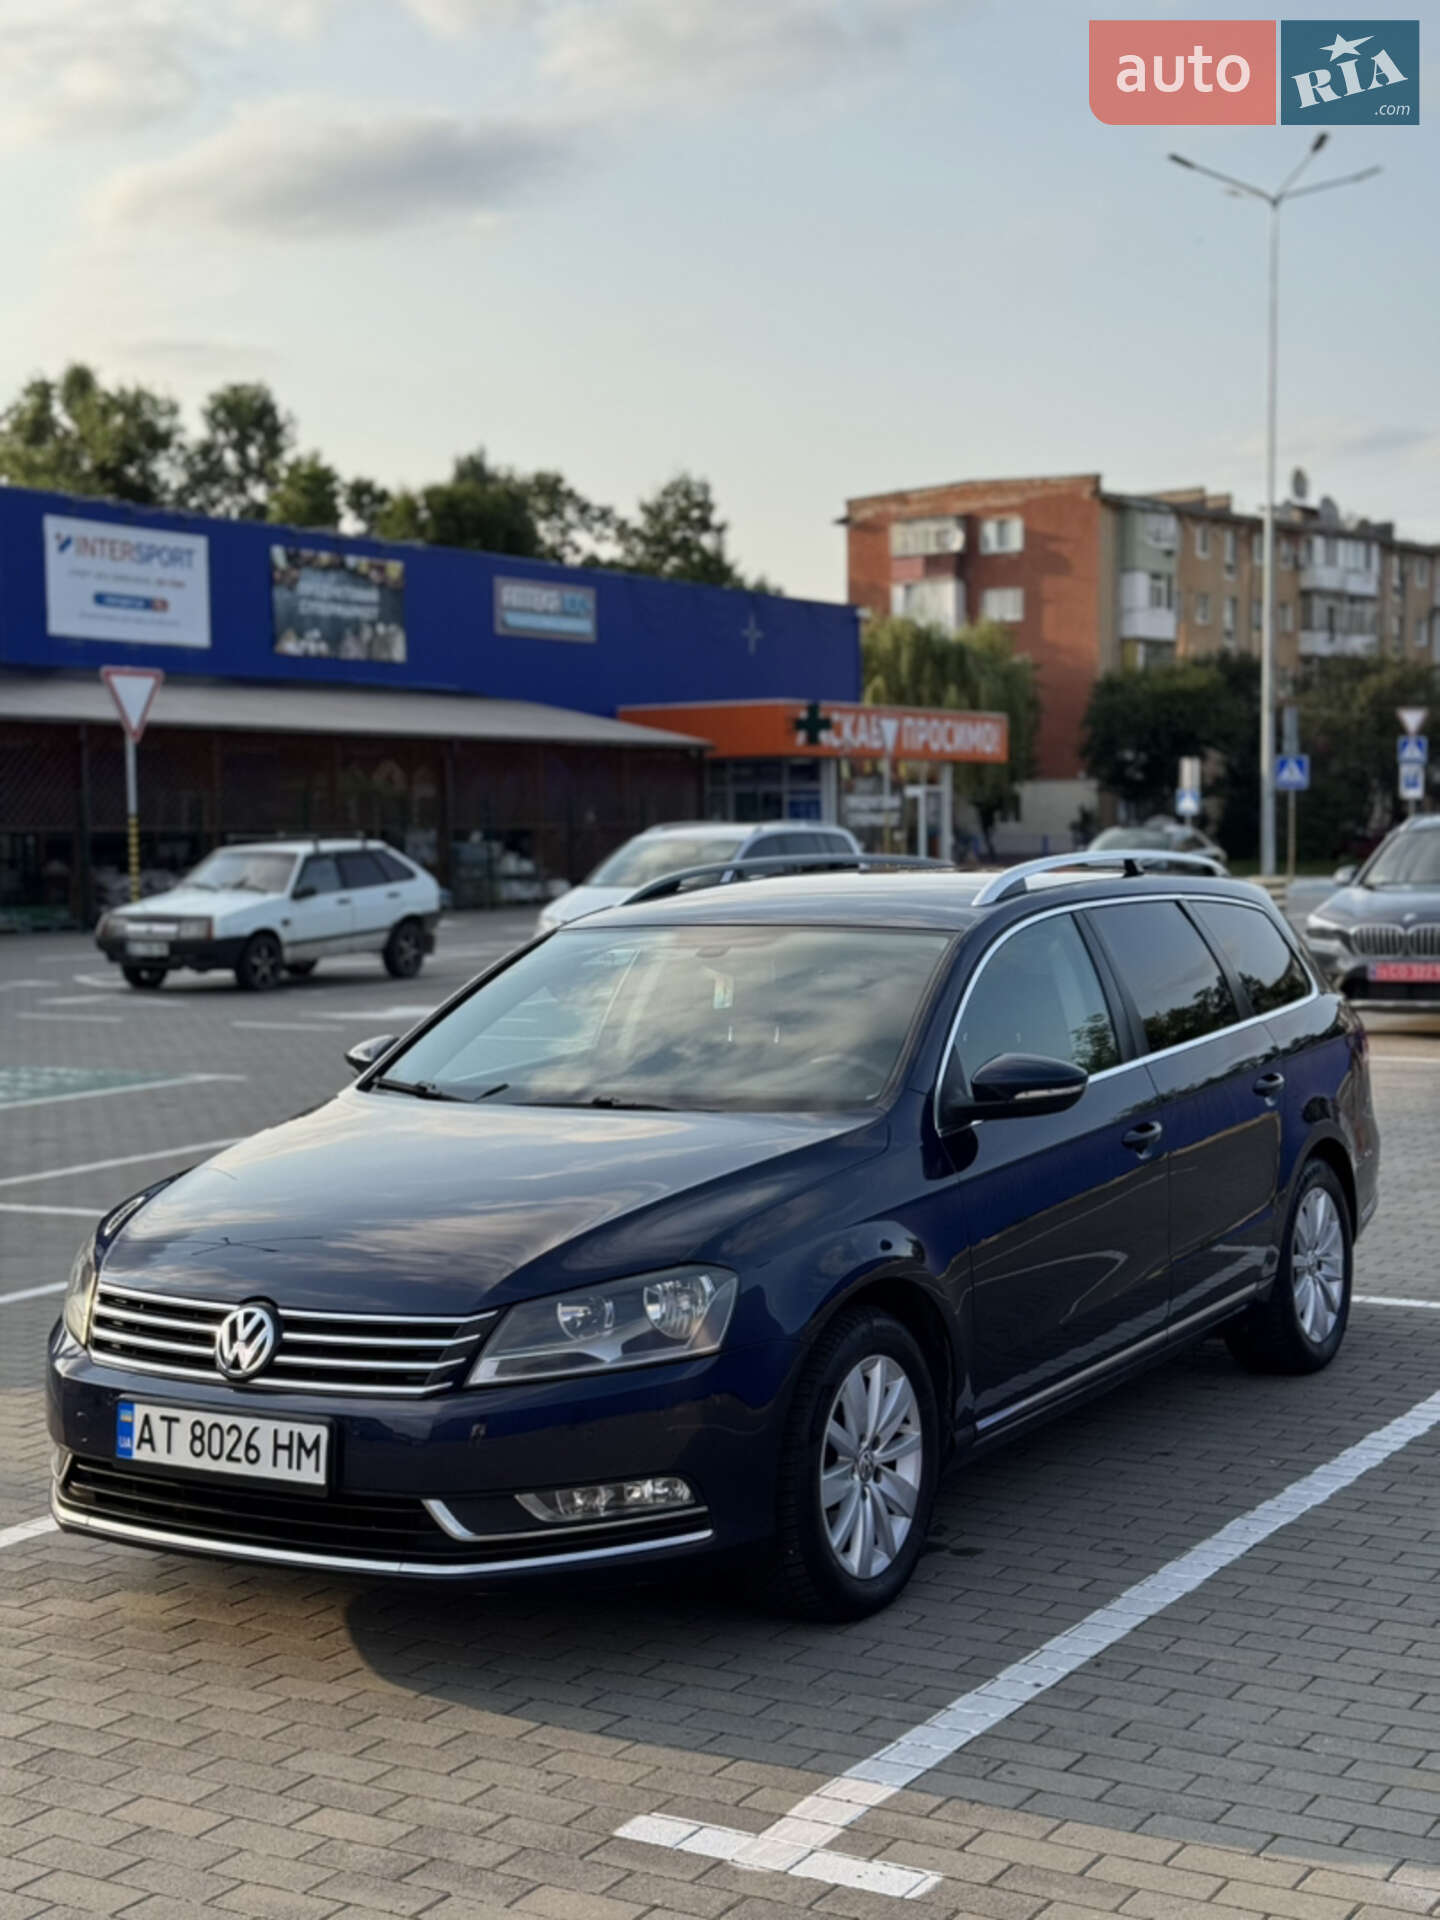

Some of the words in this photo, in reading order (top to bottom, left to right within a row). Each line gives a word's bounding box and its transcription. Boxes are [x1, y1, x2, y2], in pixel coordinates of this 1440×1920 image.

[74, 535, 195, 569] INTERSPORT
[136, 1413, 180, 1454] AT
[189, 1419, 260, 1464] 8026
[272, 1428, 321, 1473] HM
